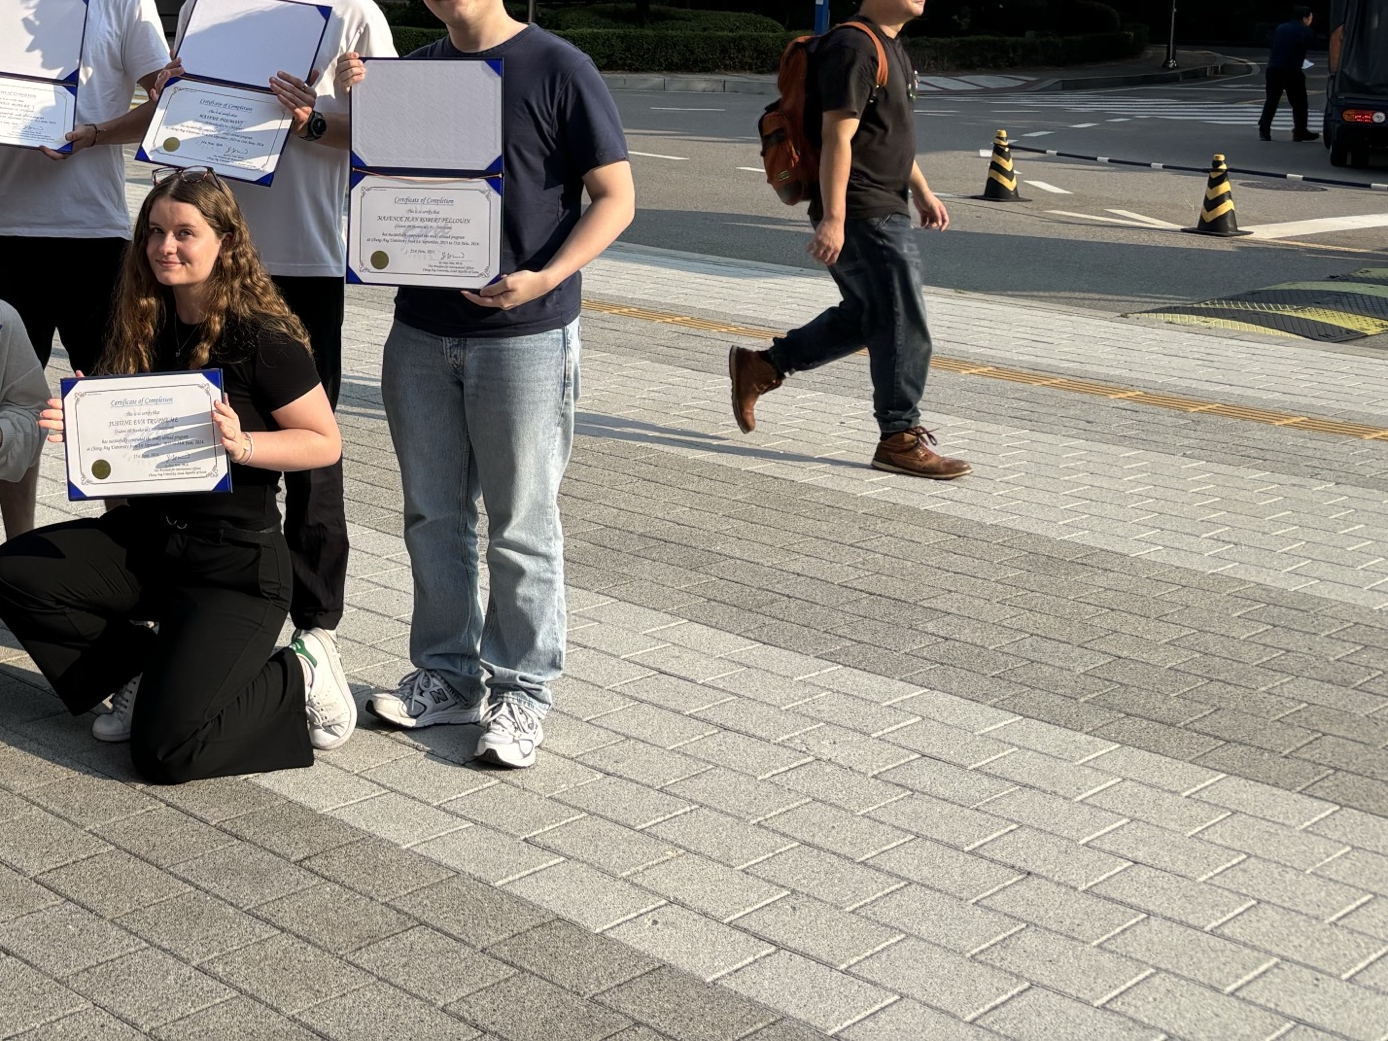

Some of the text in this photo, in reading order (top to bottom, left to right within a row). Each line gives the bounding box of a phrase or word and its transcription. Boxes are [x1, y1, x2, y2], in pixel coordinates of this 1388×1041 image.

[394, 196, 419, 204] Certificate
[110, 396, 173, 407] Certificate of Completion
